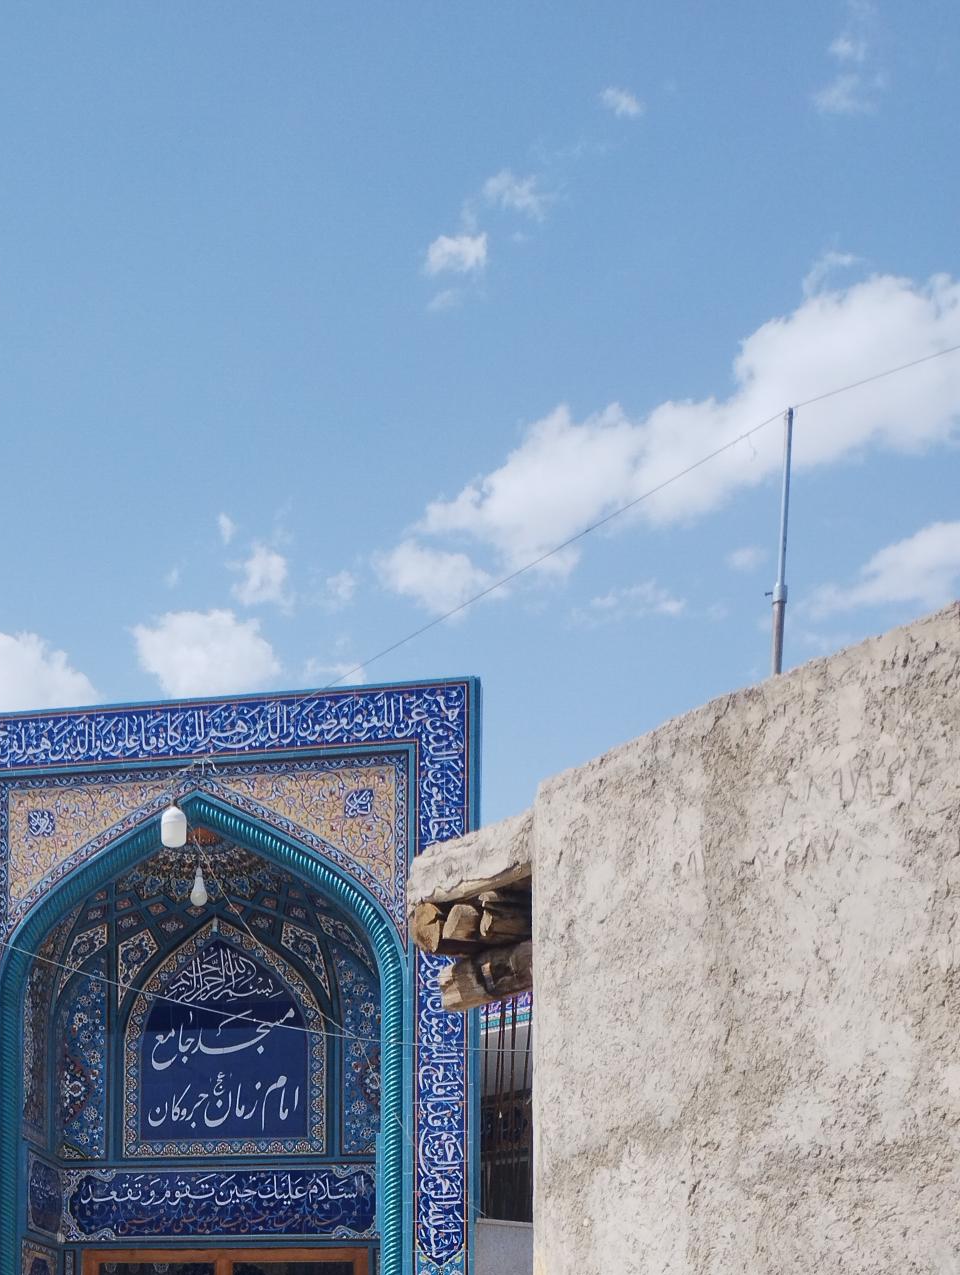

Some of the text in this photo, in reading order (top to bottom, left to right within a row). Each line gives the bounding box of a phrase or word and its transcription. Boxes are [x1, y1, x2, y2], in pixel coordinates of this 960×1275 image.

[151, 1007, 295, 1071] مسجد جامع
[147, 1083, 209, 1129] جروکان
[204, 1081, 259, 1128] زمان
[261, 1074, 300, 1132] امام
